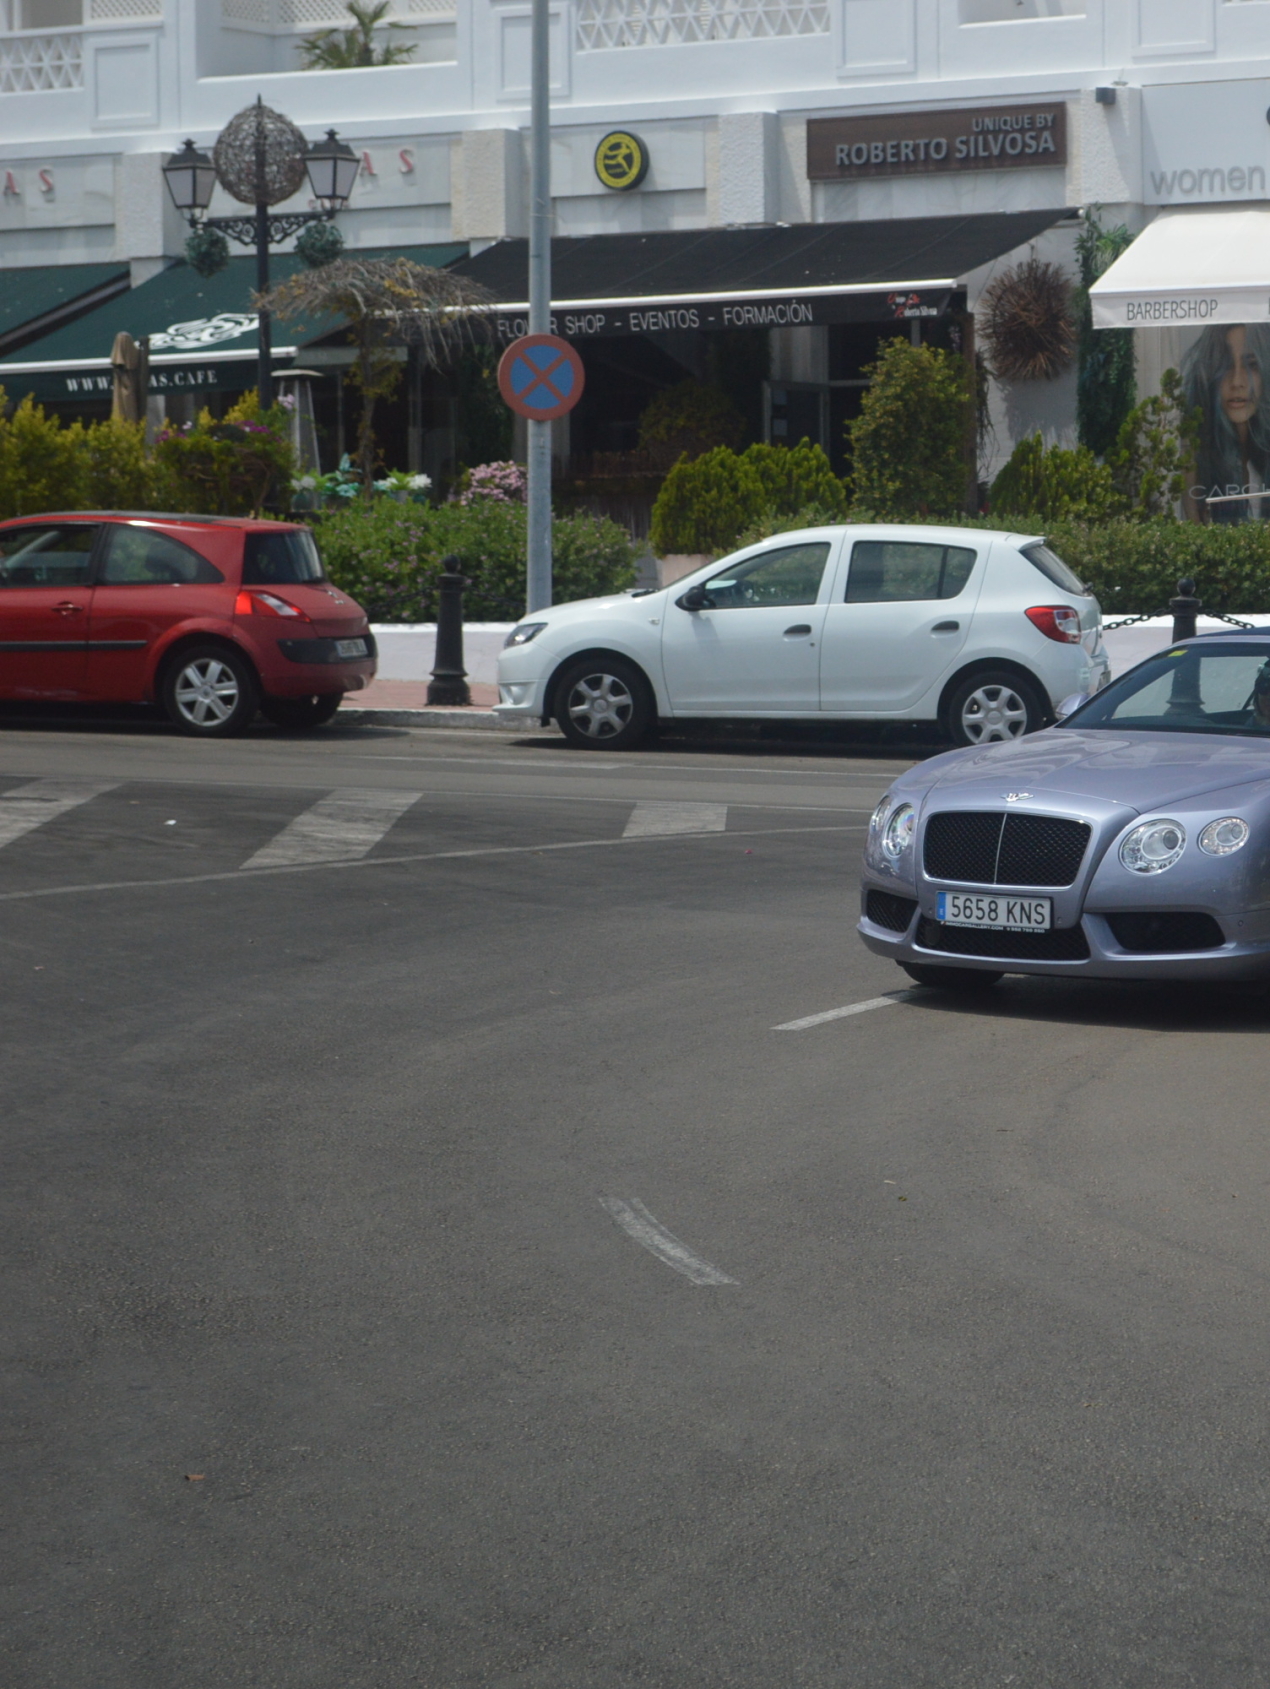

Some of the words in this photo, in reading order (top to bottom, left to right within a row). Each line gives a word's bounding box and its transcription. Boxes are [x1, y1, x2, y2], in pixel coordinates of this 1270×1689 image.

[972, 115, 1032, 132] UNIQUE
[1035, 113, 1055, 129] BY
[836, 138, 948, 166] ROBERTO
[955, 131, 1056, 159] SILVOSA
[1150, 164, 1266, 195] women
[564, 314, 606, 335] SHOP
[629, 309, 700, 331] EVENTOS
[1127, 299, 1218, 321] BARBERSHOP
[951, 896, 999, 921] 5658
[1006, 901, 1045, 925] KNS
